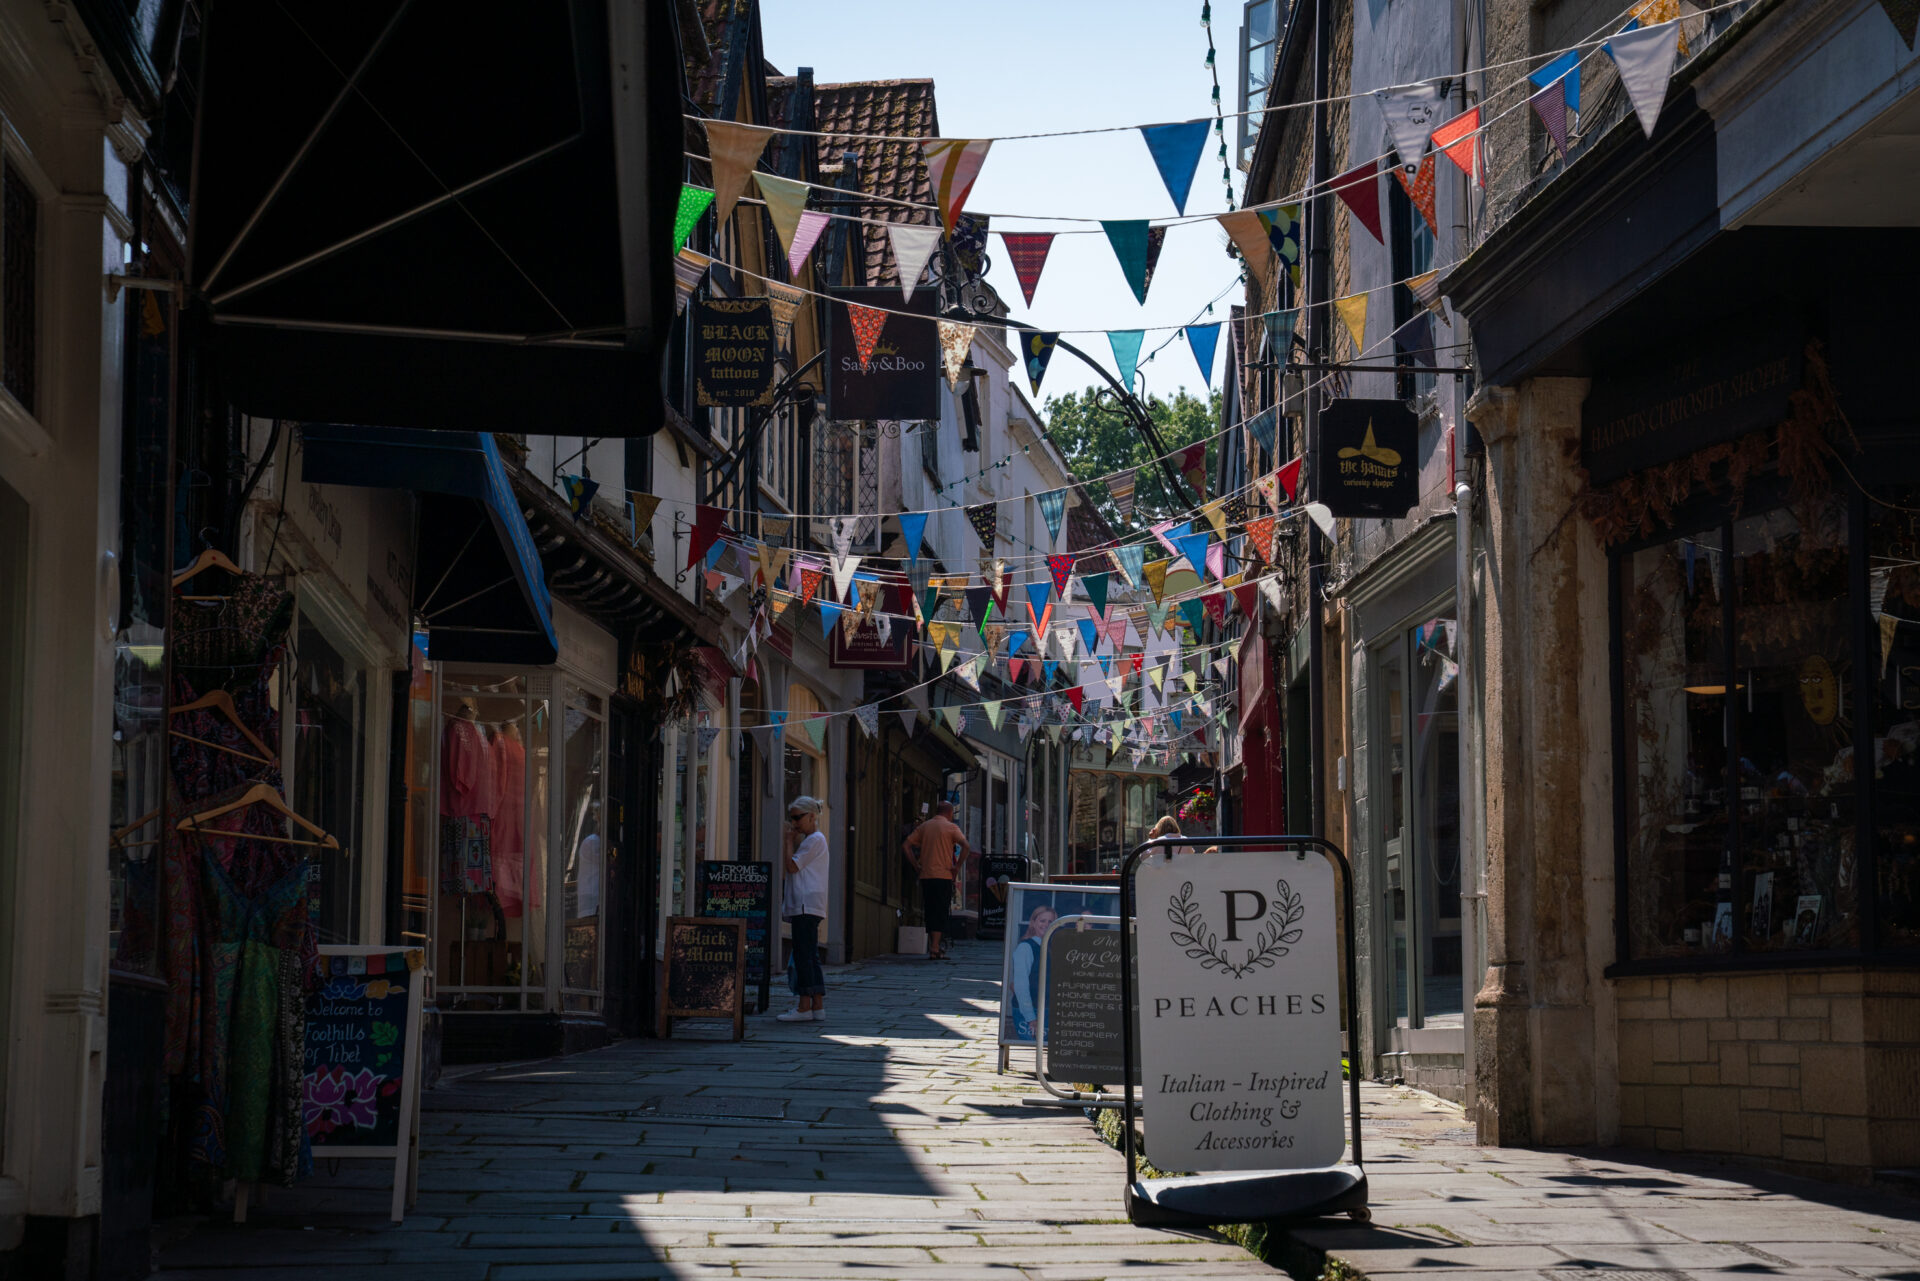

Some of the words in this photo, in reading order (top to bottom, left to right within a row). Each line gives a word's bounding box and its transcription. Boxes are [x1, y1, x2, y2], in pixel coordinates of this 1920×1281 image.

[701, 324, 770, 341] BLACK
[704, 347, 768, 363] MOON
[711, 367, 760, 380] tattoos
[1591, 409, 1646, 454] HAUNTS
[1648, 379, 1728, 432] CURIOSITY
[1731, 356, 1791, 401] SHOPPE
[1339, 460, 1358, 475] the
[1360, 459, 1399, 478] haunts
[708, 871, 769, 884] WHOLEFOODS
[721, 863, 760, 875] FROME
[1220, 889, 1267, 942] P
[679, 927, 727, 946] Black
[686, 945, 734, 963] Moon
[1066, 949, 1105, 968] Grey
[1072, 970, 1096, 978] HOME
[1098, 971, 1114, 979] AND
[1062, 982, 1117, 991] FURNITURE
[1062, 991, 1092, 1000] HOME
[304, 1000, 365, 1017] Welcome
[368, 1000, 384, 1017] to
[1061, 1000, 1104, 1010] KITCHEN
[1107, 1003, 1116, 1011] &
[1154, 993, 1326, 1018] PEACHES
[1061, 1010, 1097, 1019] LAMPS
[304, 1021, 366, 1041] Foothills
[1060, 1020, 1105, 1029] MIRRORS
[1060, 1030, 1120, 1039] STATIONERY
[1060, 1039, 1095, 1048] CARDS
[304, 1046, 321, 1065] of
[326, 1042, 361, 1063] Tibet
[1158, 1073, 1226, 1095] Italian
[1248, 1070, 1329, 1099] Inspired
[1189, 1101, 1274, 1128] Clothing
[1279, 1099, 1302, 1120] &
[1195, 1130, 1295, 1151] Accessories
